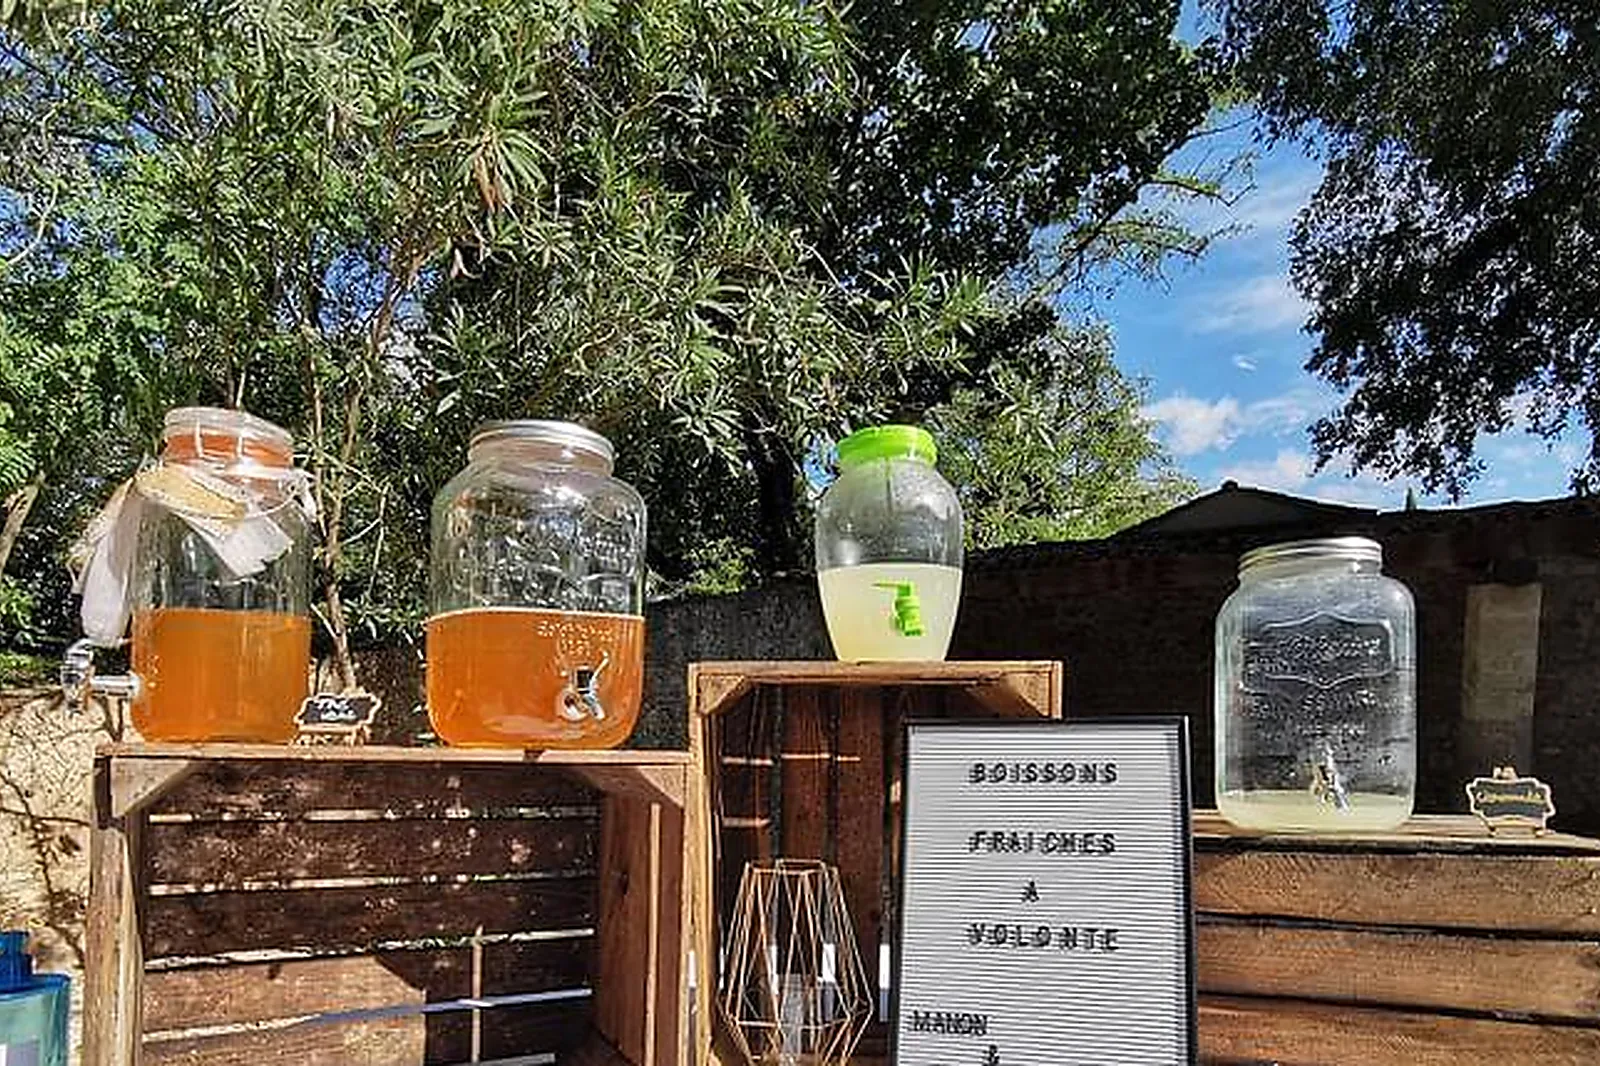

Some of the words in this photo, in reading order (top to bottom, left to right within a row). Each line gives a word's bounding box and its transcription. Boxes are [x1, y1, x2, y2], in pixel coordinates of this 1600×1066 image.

[971, 763, 1118, 783] BOISSONS
[971, 832, 1115, 853] FRAICHES
[1023, 881, 1040, 902] A
[971, 923, 1120, 949] VOLONTE
[911, 1009, 988, 1035] MANON
